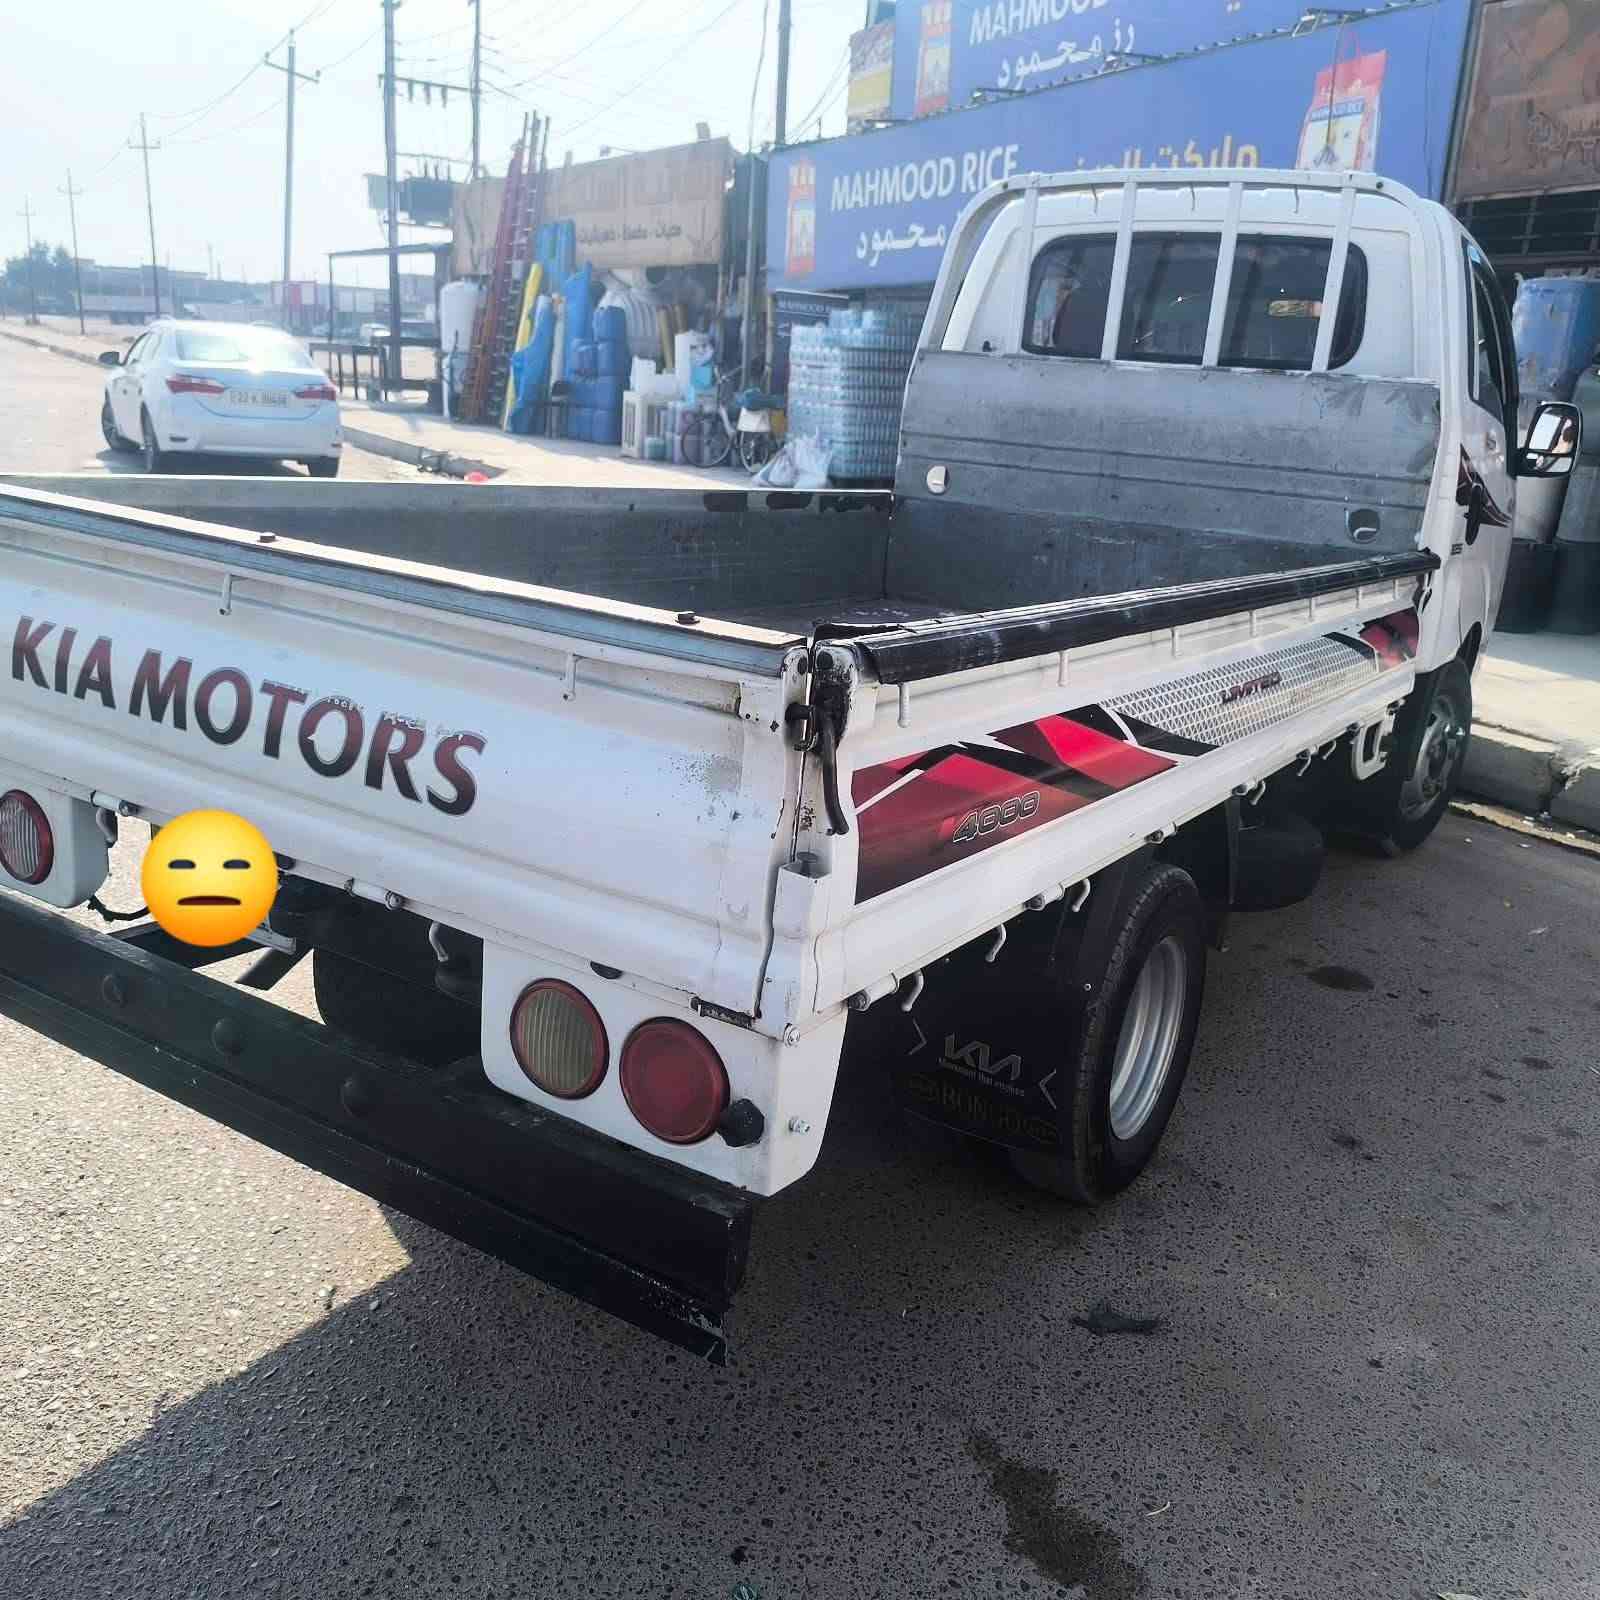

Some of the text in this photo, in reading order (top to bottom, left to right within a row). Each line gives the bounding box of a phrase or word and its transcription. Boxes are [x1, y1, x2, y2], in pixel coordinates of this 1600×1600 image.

[969, 0, 1110, 46] MAHMO
[830, 155, 956, 212] MAHMOOD
[855, 222, 948, 267] محمود
[12, 615, 489, 817] KIA MOTORS
